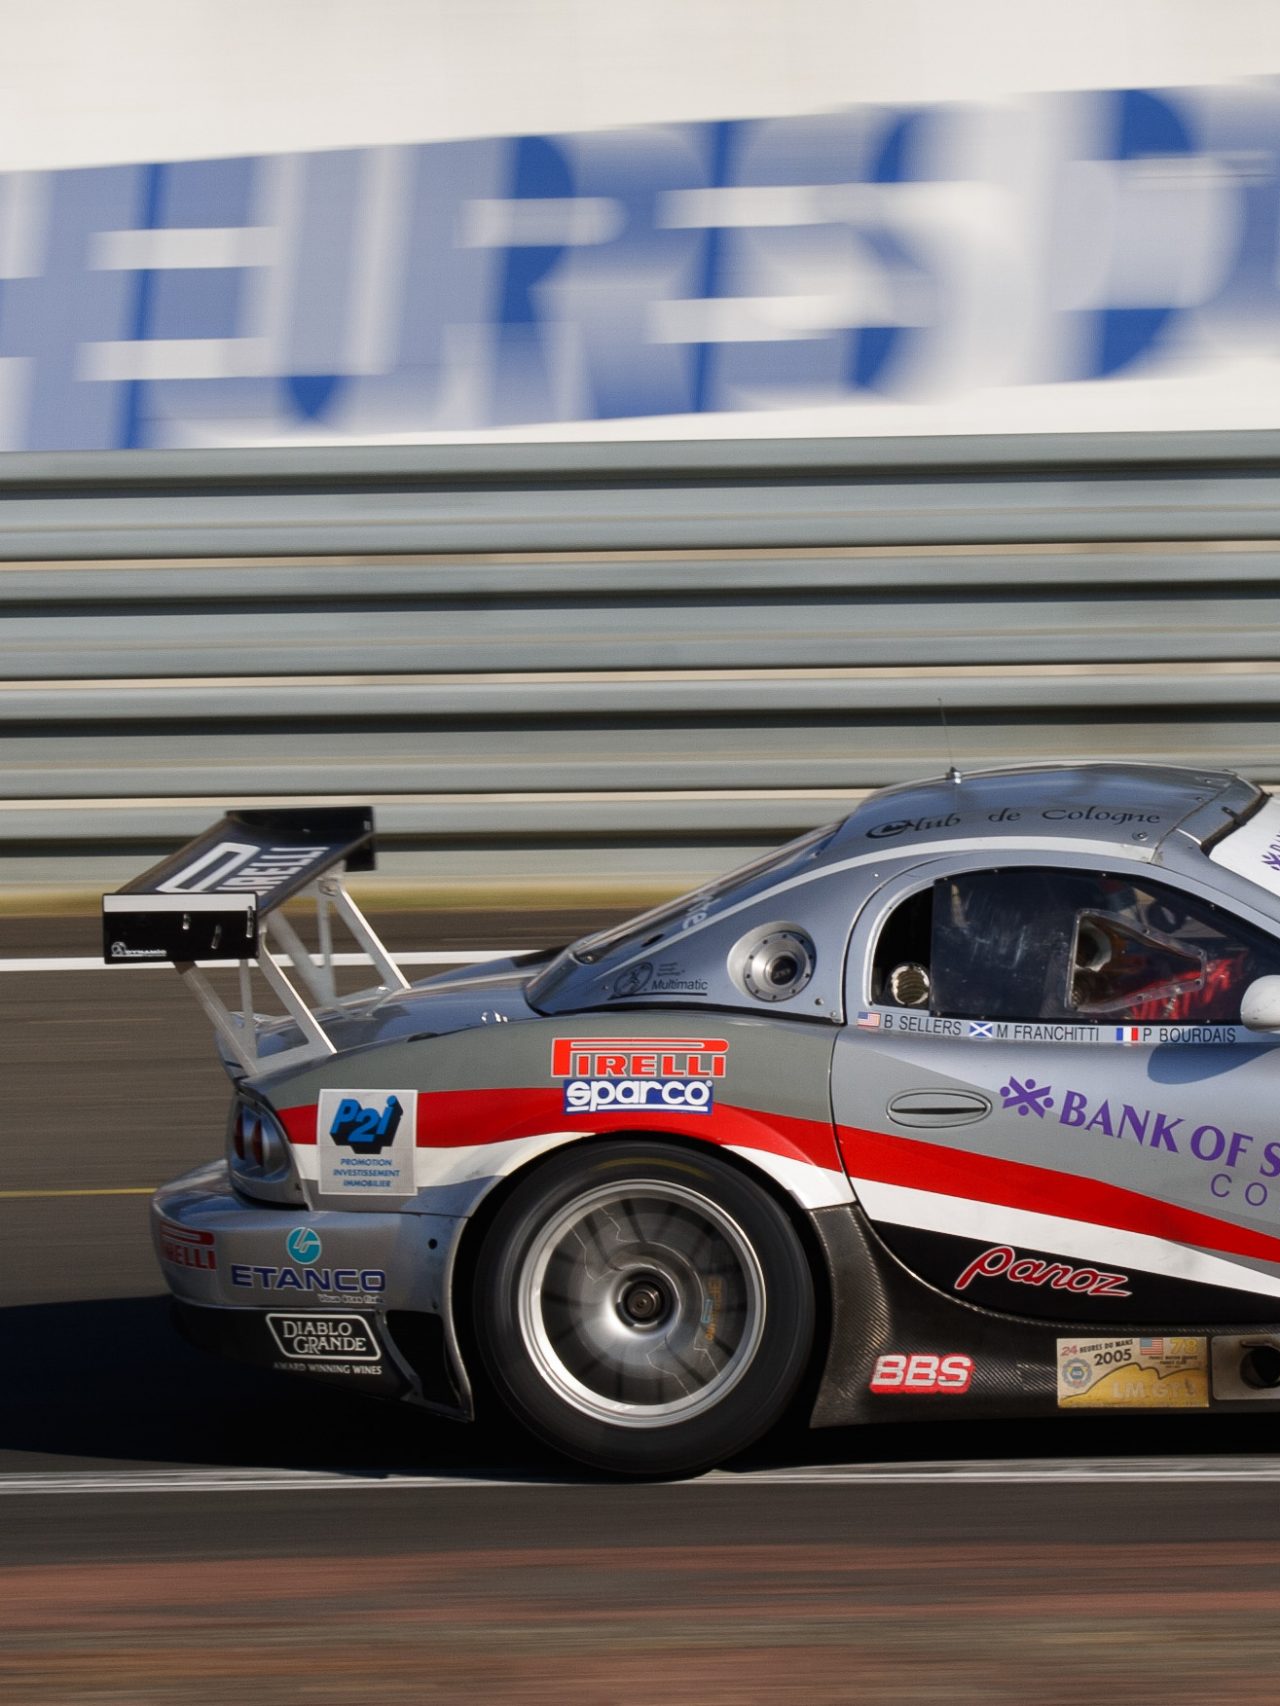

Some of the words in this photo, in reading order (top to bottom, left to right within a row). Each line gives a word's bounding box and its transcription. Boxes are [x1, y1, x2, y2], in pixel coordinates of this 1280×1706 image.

[865, 812, 961, 840] Club
[989, 806, 1022, 823] de
[1042, 806, 1161, 825] Cologne
[651, 979, 708, 991] Multimatic
[883, 1015, 893, 1029] B
[898, 1016, 963, 1036] SELLERS
[996, 1024, 1009, 1038] M
[1013, 1024, 1100, 1042] FRANCHITTI
[1143, 1028, 1152, 1042] P
[1159, 1028, 1237, 1043] BOURDAIS
[551, 1037, 729, 1078] PIRELLI
[566, 1079, 712, 1112] sparco
[1058, 1089, 1186, 1155] BANK
[1189, 1124, 1255, 1169] OF
[340, 1158, 392, 1166] PROMOTION
[333, 1169, 400, 1177] INVESTISSEMENT
[343, 1180, 391, 1188] IMMOBILIER
[231, 1264, 386, 1292] ETANCO
[282, 1321, 352, 1338] DIABLO
[293, 1337, 367, 1354] GRANDE
[1060, 1345, 1079, 1357] 24
[1168, 1338, 1198, 1354] 78
[1093, 1348, 1132, 1366] 2005
[307, 1364, 351, 1375] WINNING
[352, 1365, 382, 1375] WINES
[872, 1355, 971, 1390] BBS
